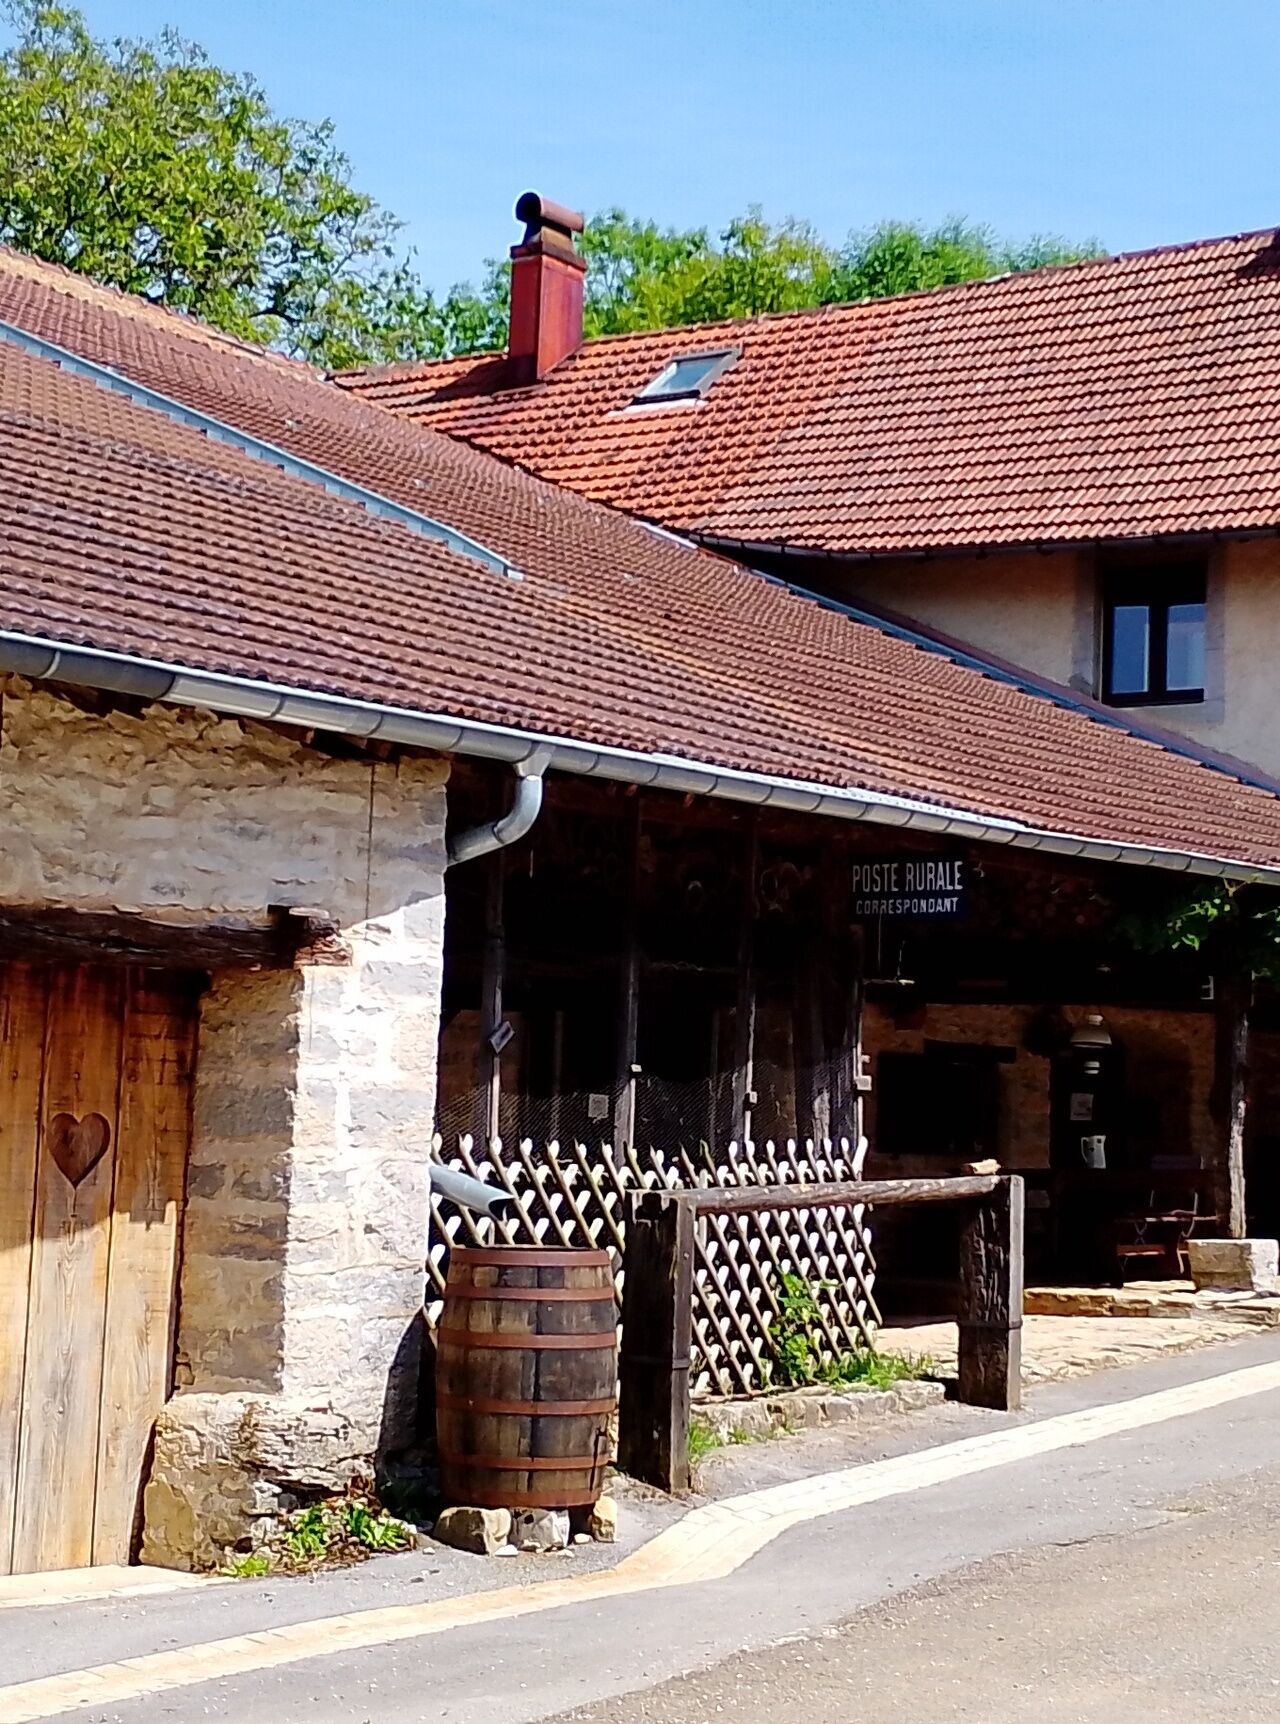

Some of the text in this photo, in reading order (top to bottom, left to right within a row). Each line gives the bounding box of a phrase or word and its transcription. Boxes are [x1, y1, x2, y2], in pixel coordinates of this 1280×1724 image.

[852, 861, 963, 892] POSTE RURALE
[856, 897, 959, 914] CORRESPONDANT
